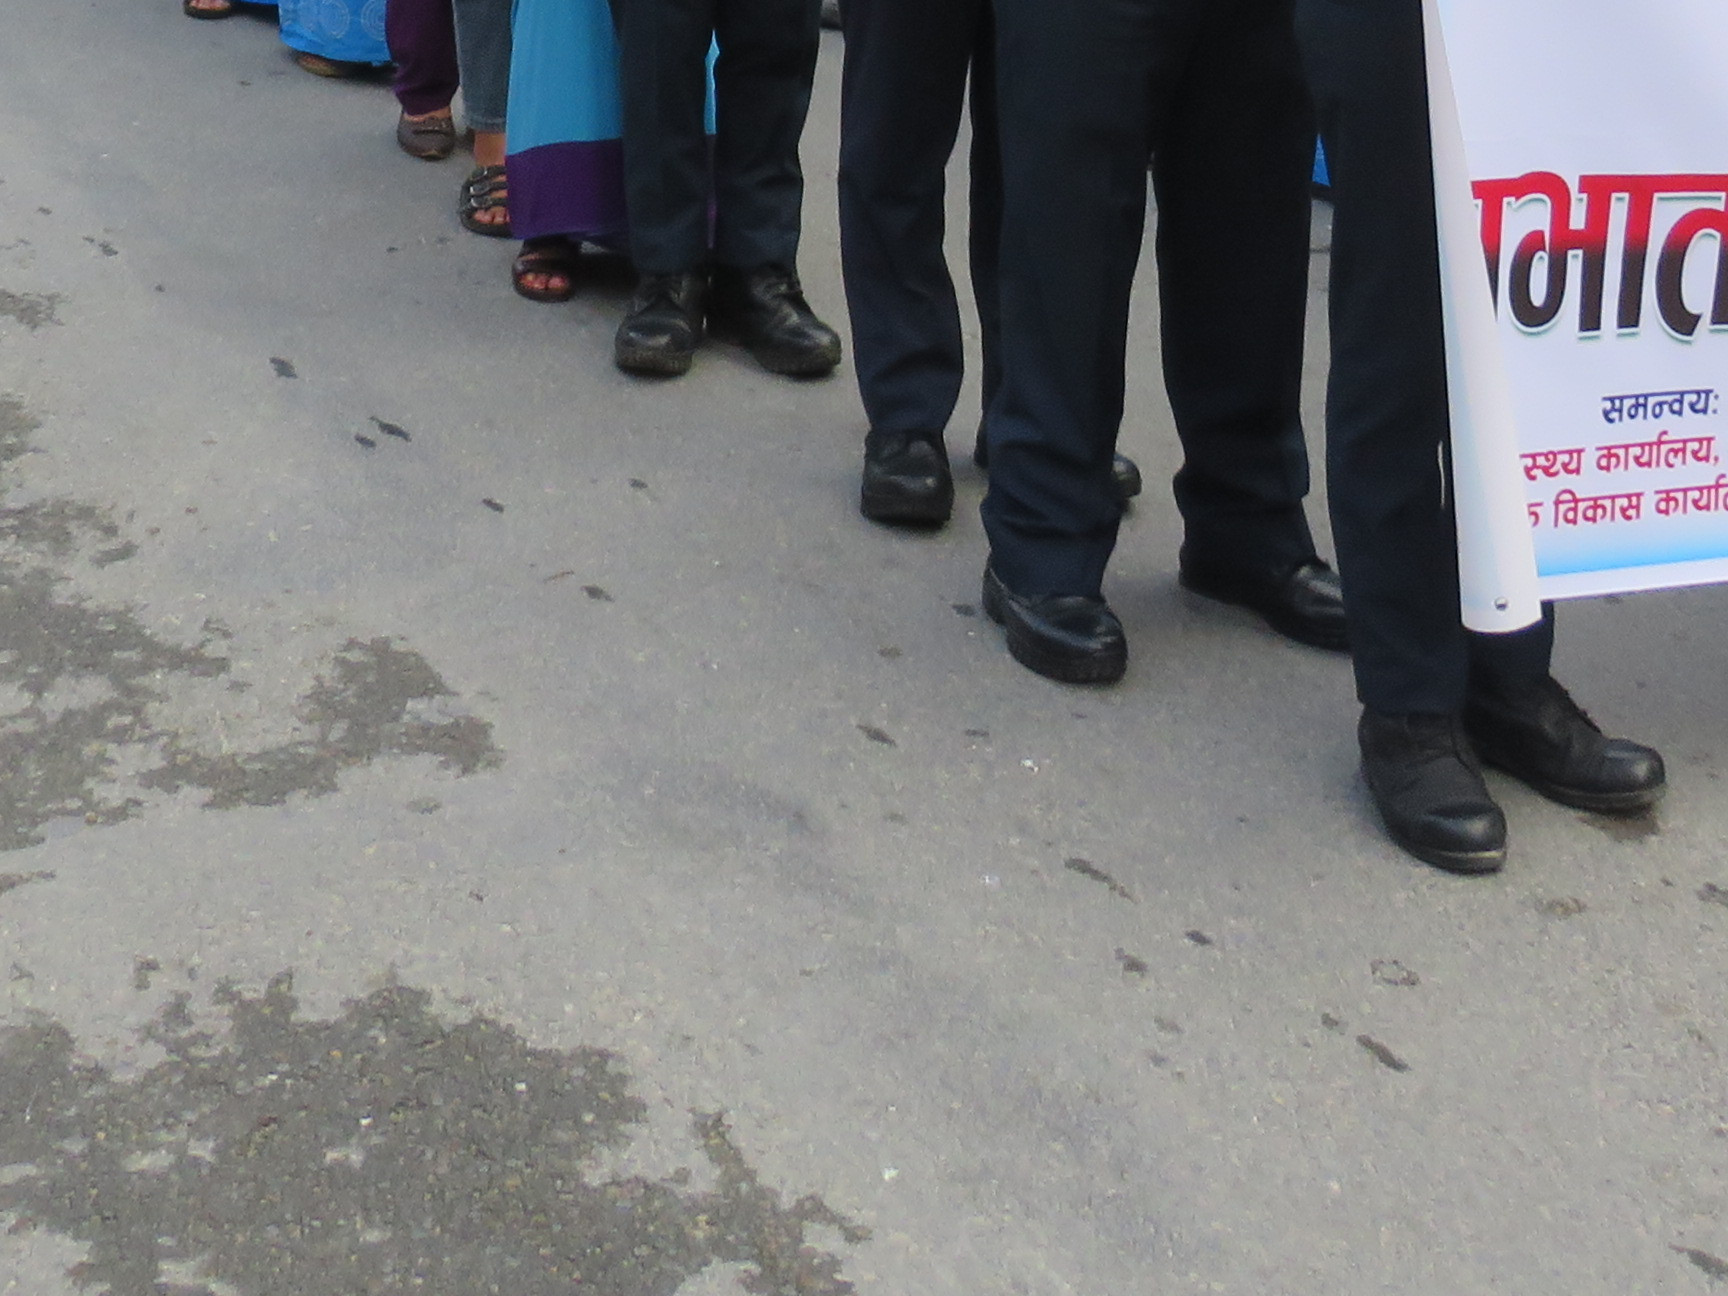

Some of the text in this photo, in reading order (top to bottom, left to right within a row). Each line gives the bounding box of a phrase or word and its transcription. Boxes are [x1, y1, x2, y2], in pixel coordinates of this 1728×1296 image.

[1601, 388, 1720, 424] समन्वय:
[1595, 430, 1720, 474] कार्यालय,
[1553, 488, 1645, 529] विकास
